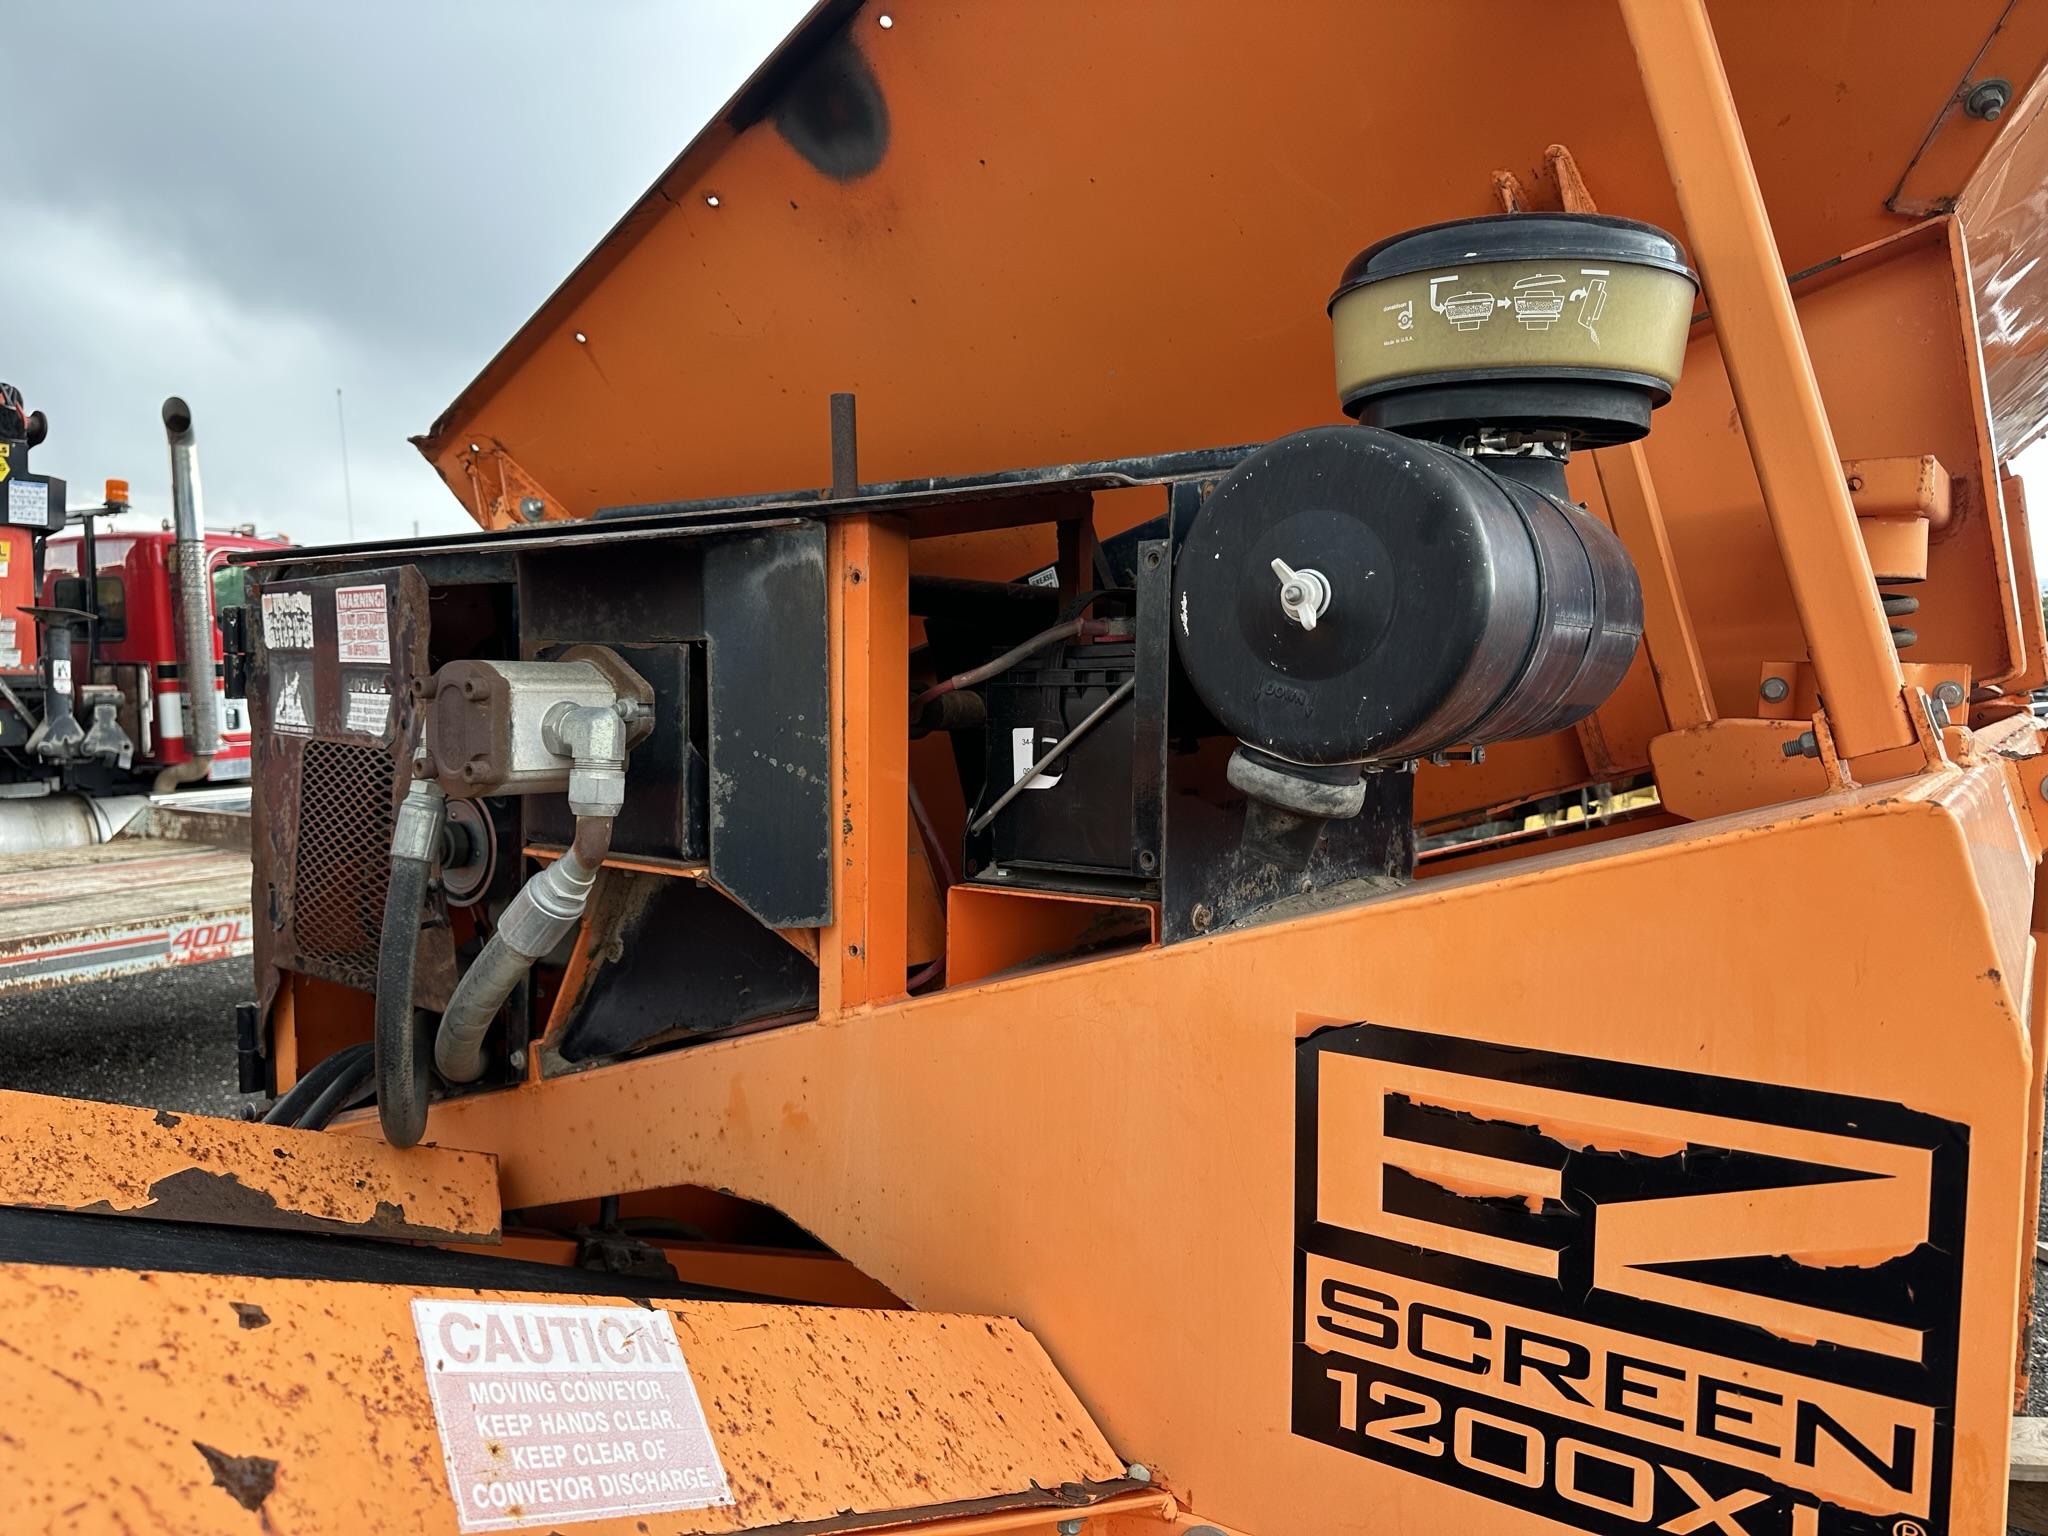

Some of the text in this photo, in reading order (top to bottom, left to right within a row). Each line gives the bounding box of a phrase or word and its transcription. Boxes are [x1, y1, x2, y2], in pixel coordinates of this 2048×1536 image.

[338, 592, 385, 609] WARNING!
[439, 1313, 670, 1364] CAUTION
[468, 1381, 557, 1405] MOVING
[1317, 1278, 1917, 1493] SCREEN
[475, 1409, 681, 1438] KEEP HANDS CLEAR.
[511, 1439, 667, 1470] KEEP CLEAR OF
[472, 1467, 716, 1510] CONVEYOR DISCHARGE.
